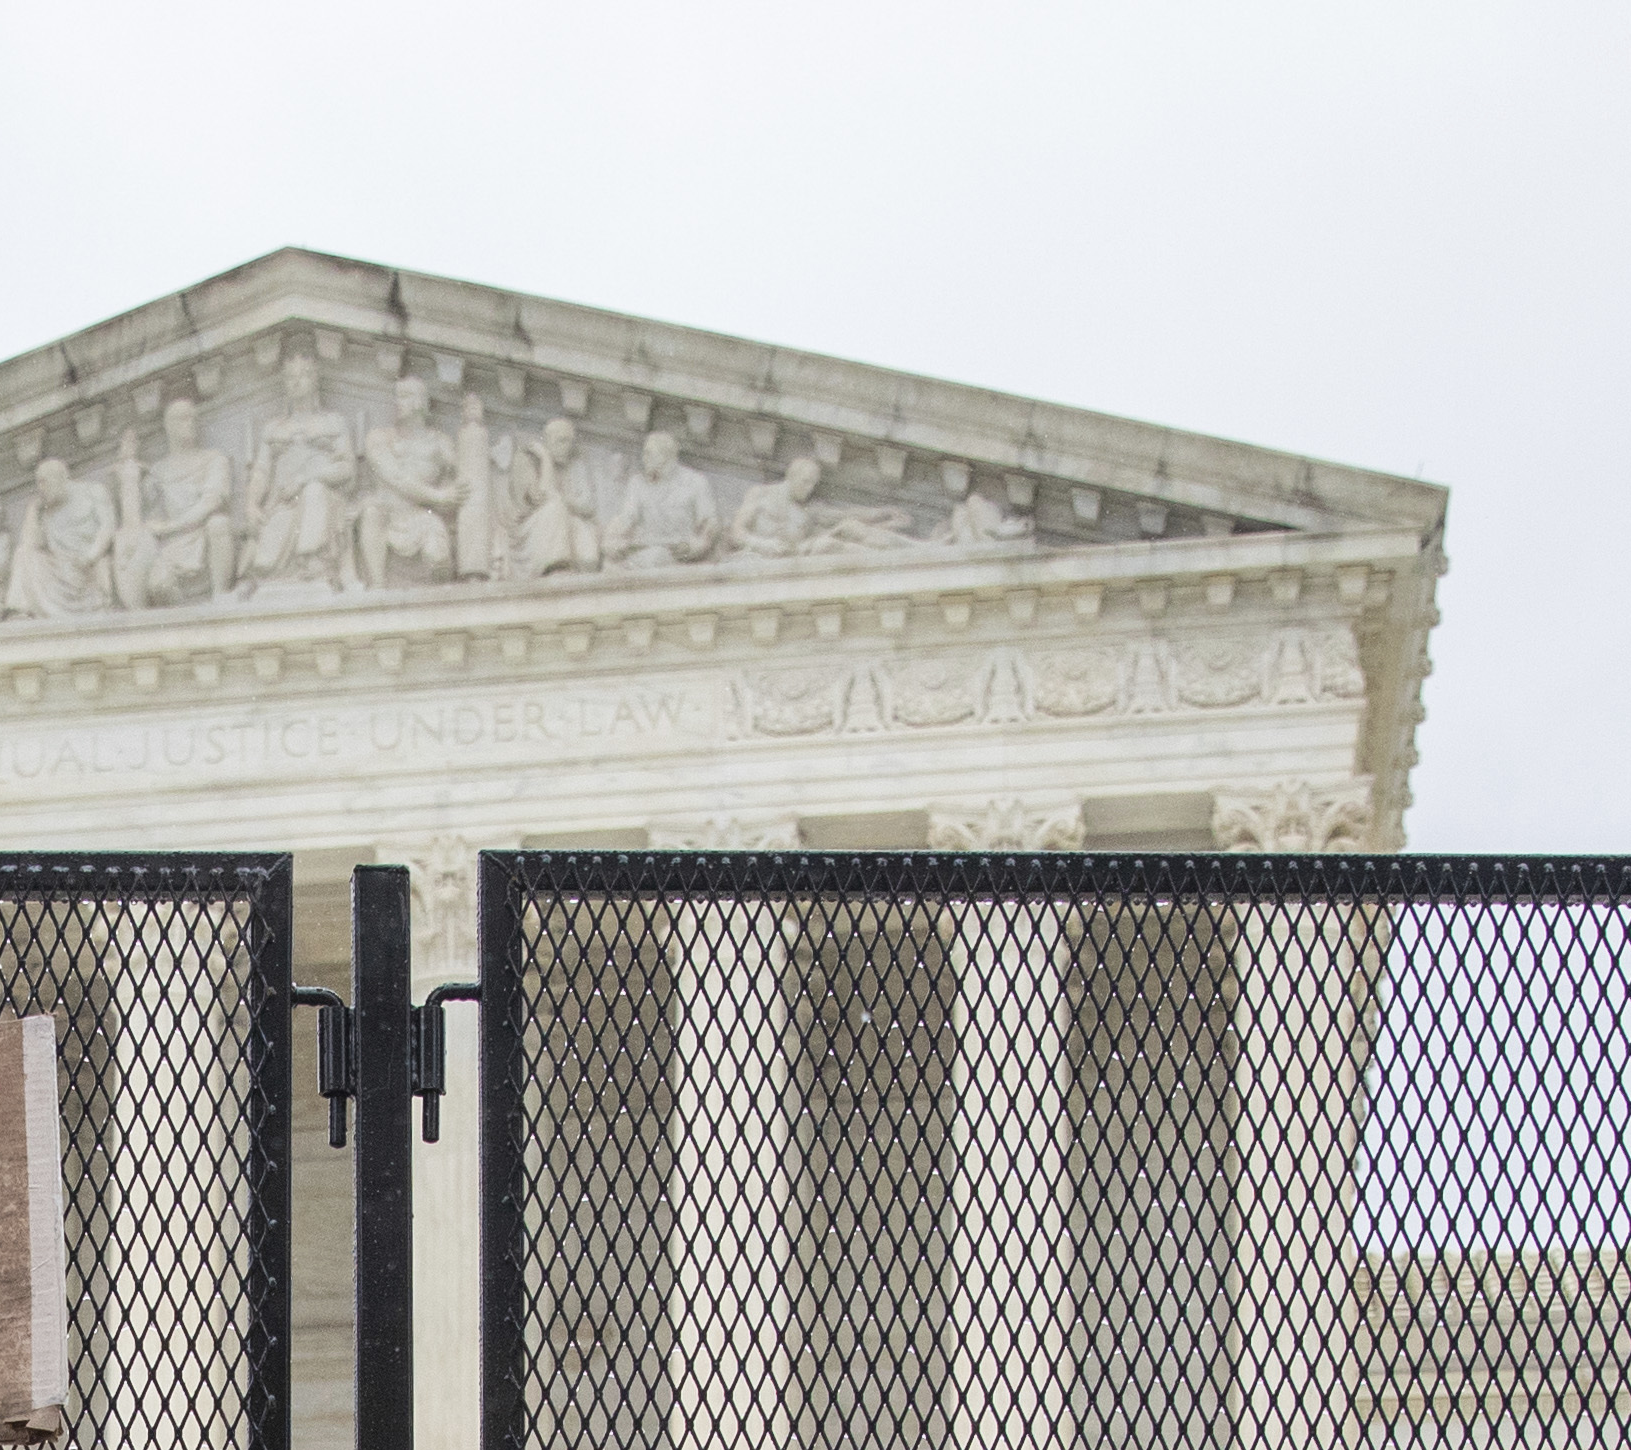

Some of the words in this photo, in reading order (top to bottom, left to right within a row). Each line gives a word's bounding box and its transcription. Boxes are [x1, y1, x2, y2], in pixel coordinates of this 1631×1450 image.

[128, 716, 338, 771] JUSTICE
[369, 703, 552, 752] UNDER
[580, 692, 687, 738] LAW
